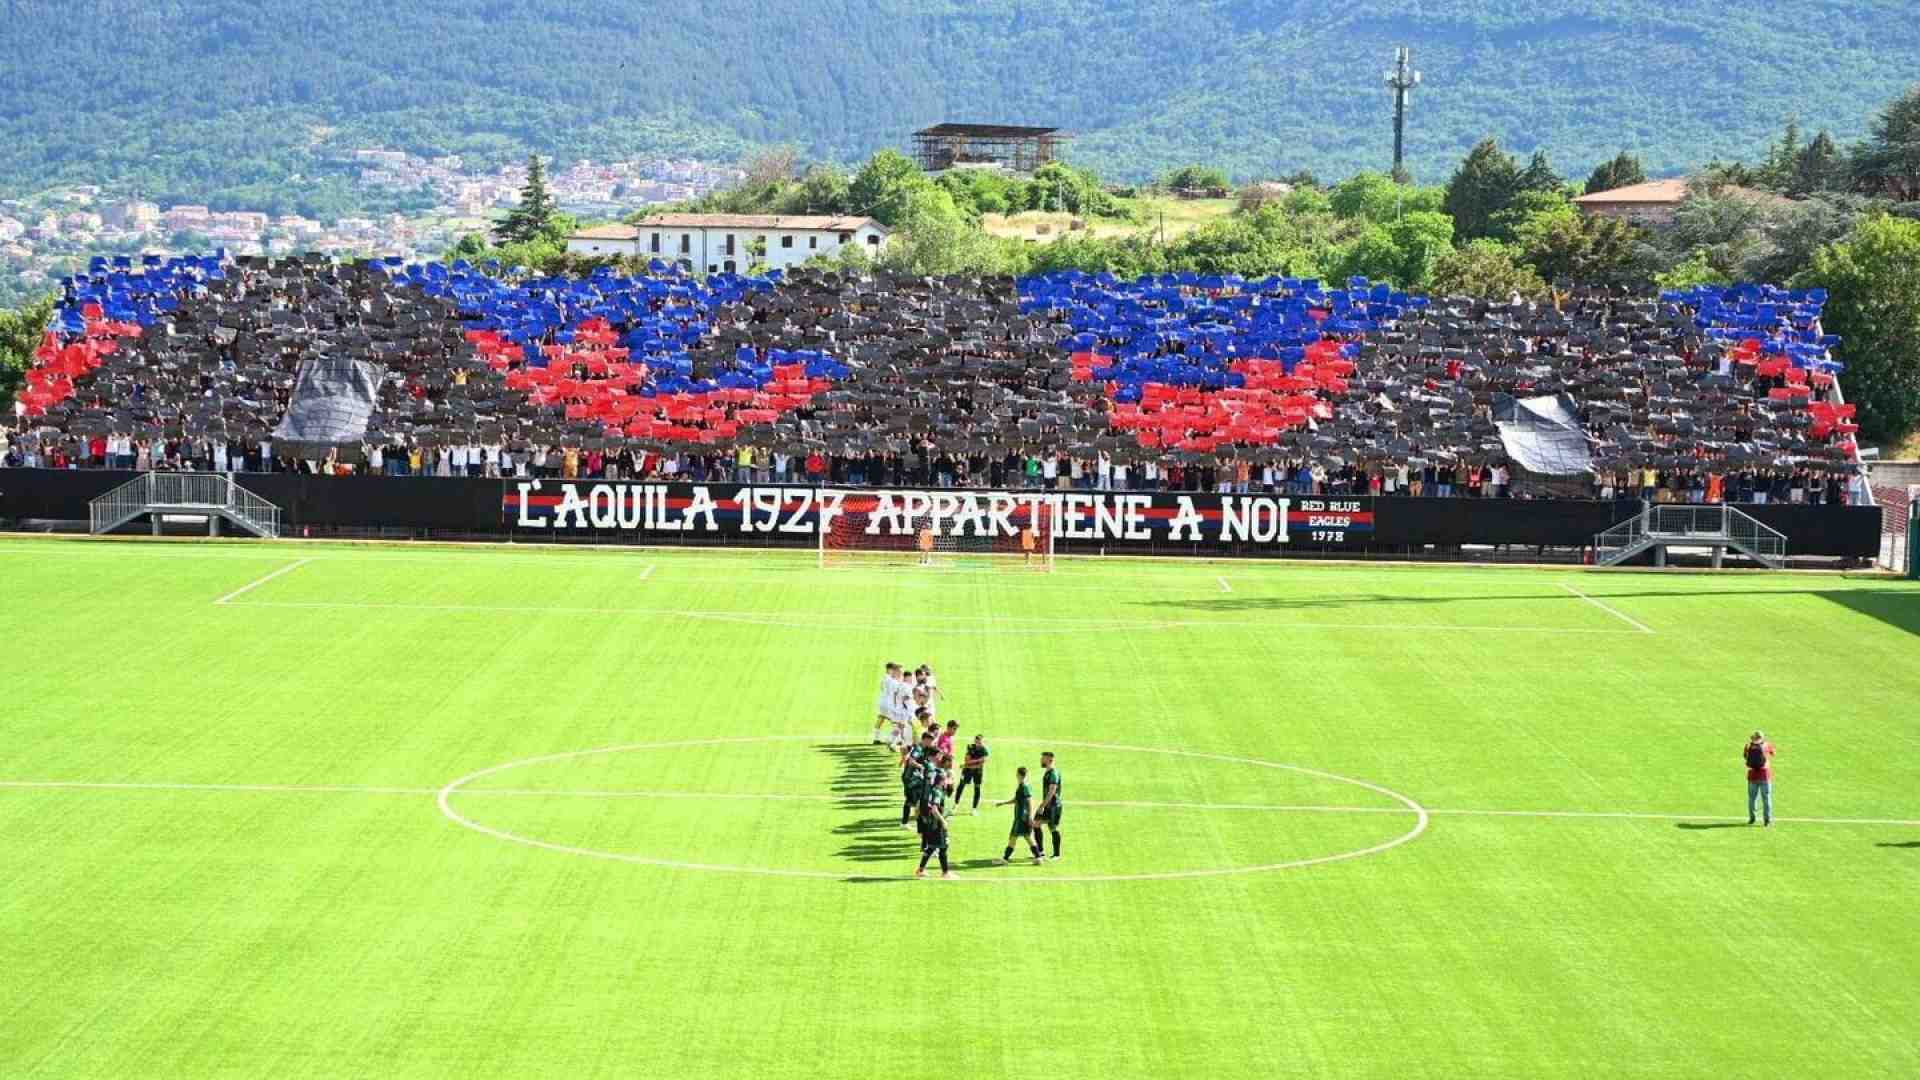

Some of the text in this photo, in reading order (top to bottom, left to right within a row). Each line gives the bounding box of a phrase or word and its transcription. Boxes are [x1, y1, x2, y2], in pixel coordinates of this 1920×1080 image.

[517, 479, 1289, 542] L'AQUILA 1927 APPARTIENE A NOI
[1301, 501, 1361, 512] RED BLUE
[1309, 516, 1351, 527] EAGLES
[1312, 531, 1344, 541] 1978
